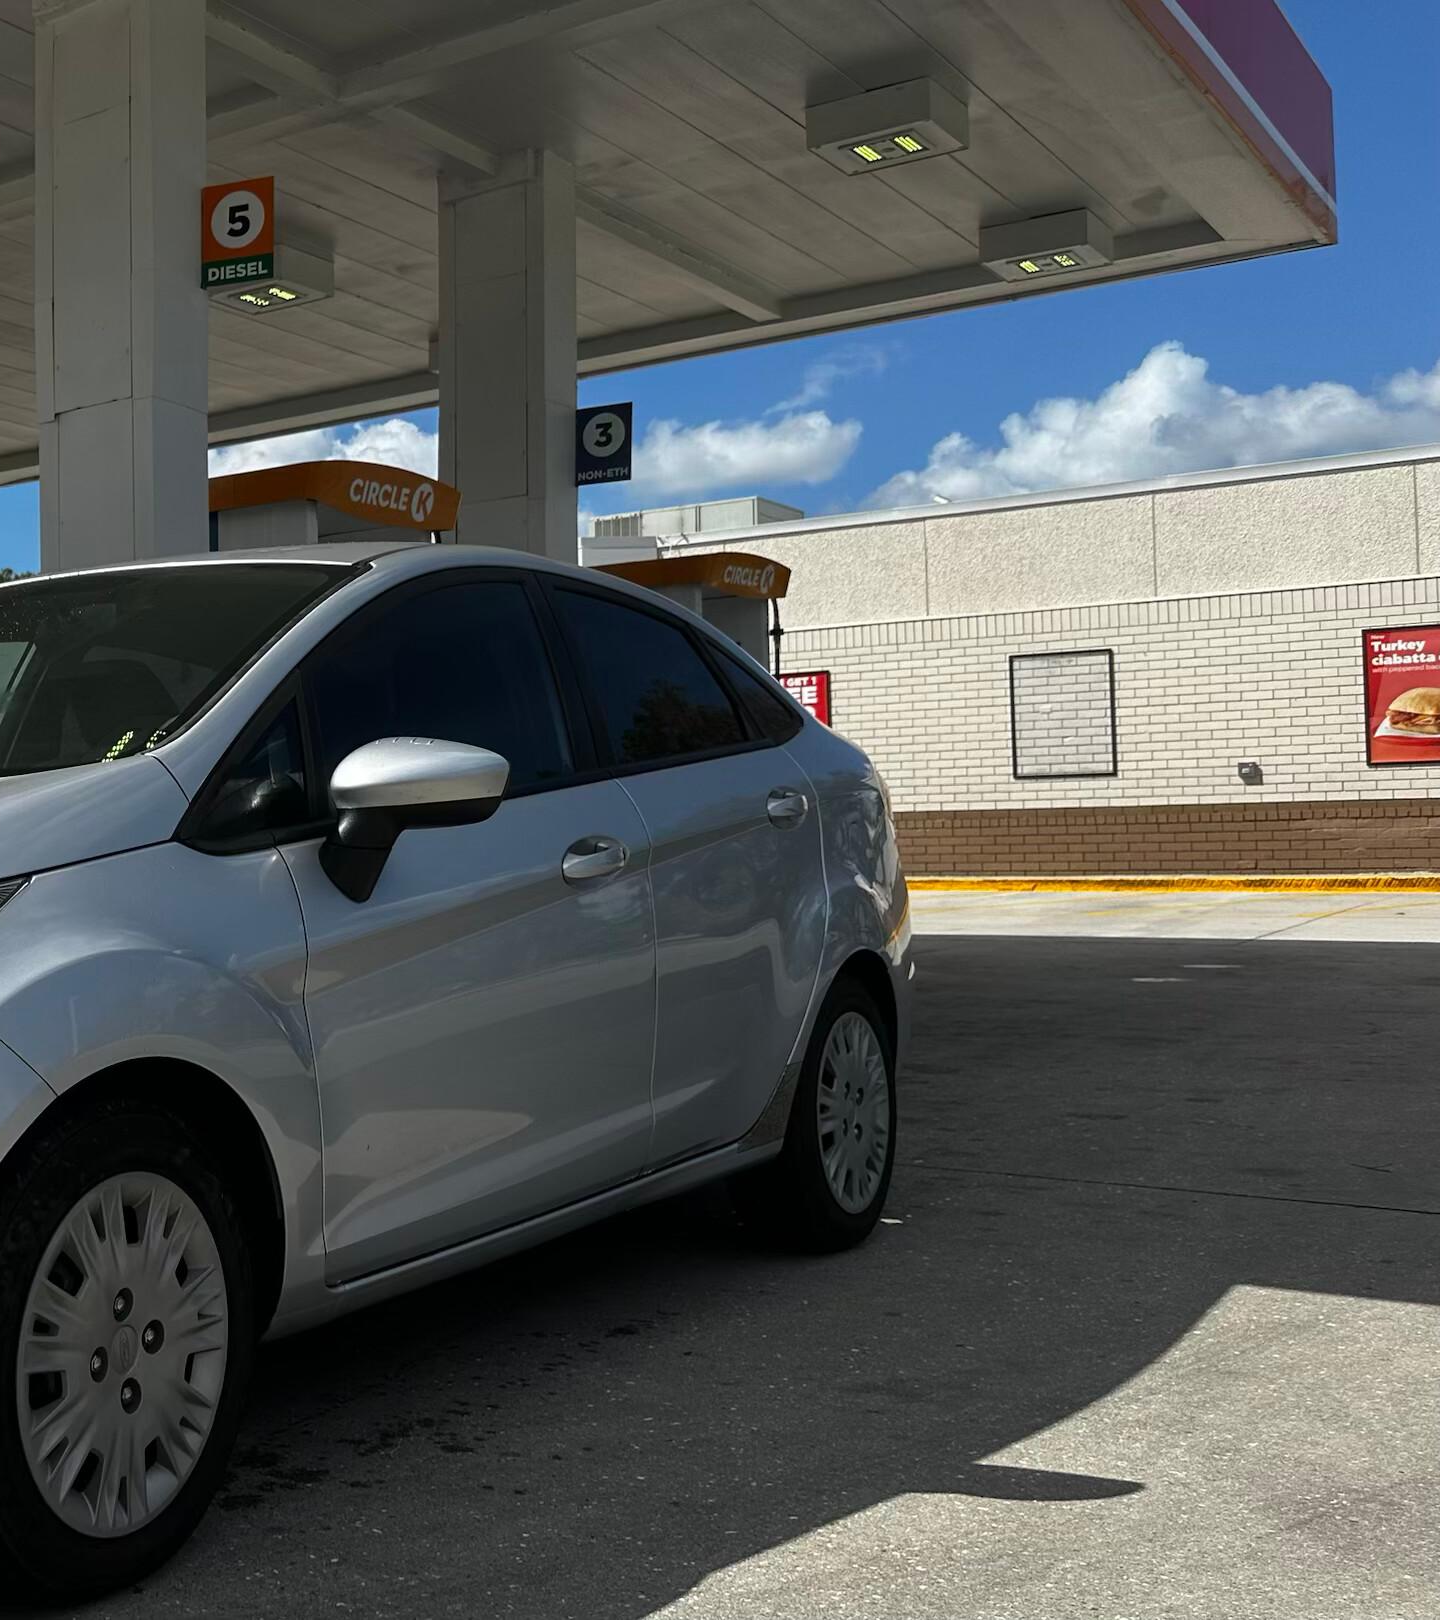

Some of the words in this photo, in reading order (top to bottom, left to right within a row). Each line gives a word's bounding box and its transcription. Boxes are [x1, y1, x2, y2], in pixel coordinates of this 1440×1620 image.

[226, 204, 250, 237] 5
[208, 261, 268, 282] DIESEL
[594, 422, 612, 447] 3
[350, 478, 410, 511] CIRCLE
[411, 483, 434, 522] K
[724, 565, 761, 586] CIRCLE
[1370, 640, 1425, 652] Turkey
[1372, 653, 1436, 666] ciabatta
[786, 677, 809, 687] GET
[811, 676, 817, 685] 1
